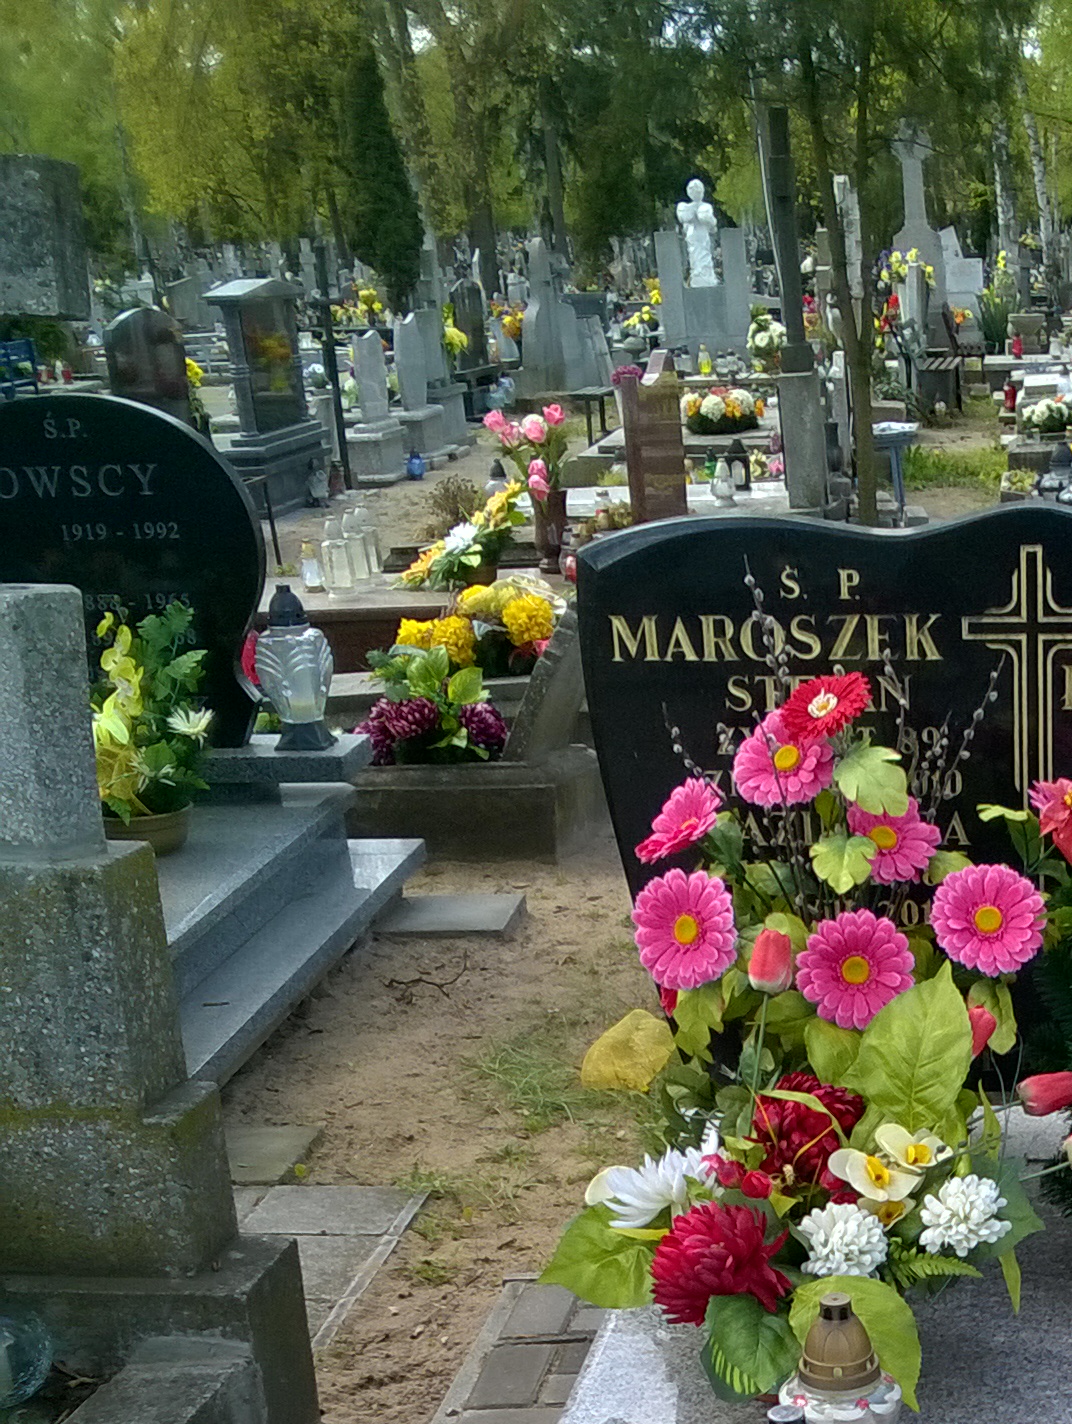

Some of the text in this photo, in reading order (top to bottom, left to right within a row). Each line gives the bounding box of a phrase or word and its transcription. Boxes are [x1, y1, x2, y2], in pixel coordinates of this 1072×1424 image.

[61, 523, 107, 541] 1919
[133, 521, 180, 539] 1992
[608, 614, 944, 663] MAROSZEK
